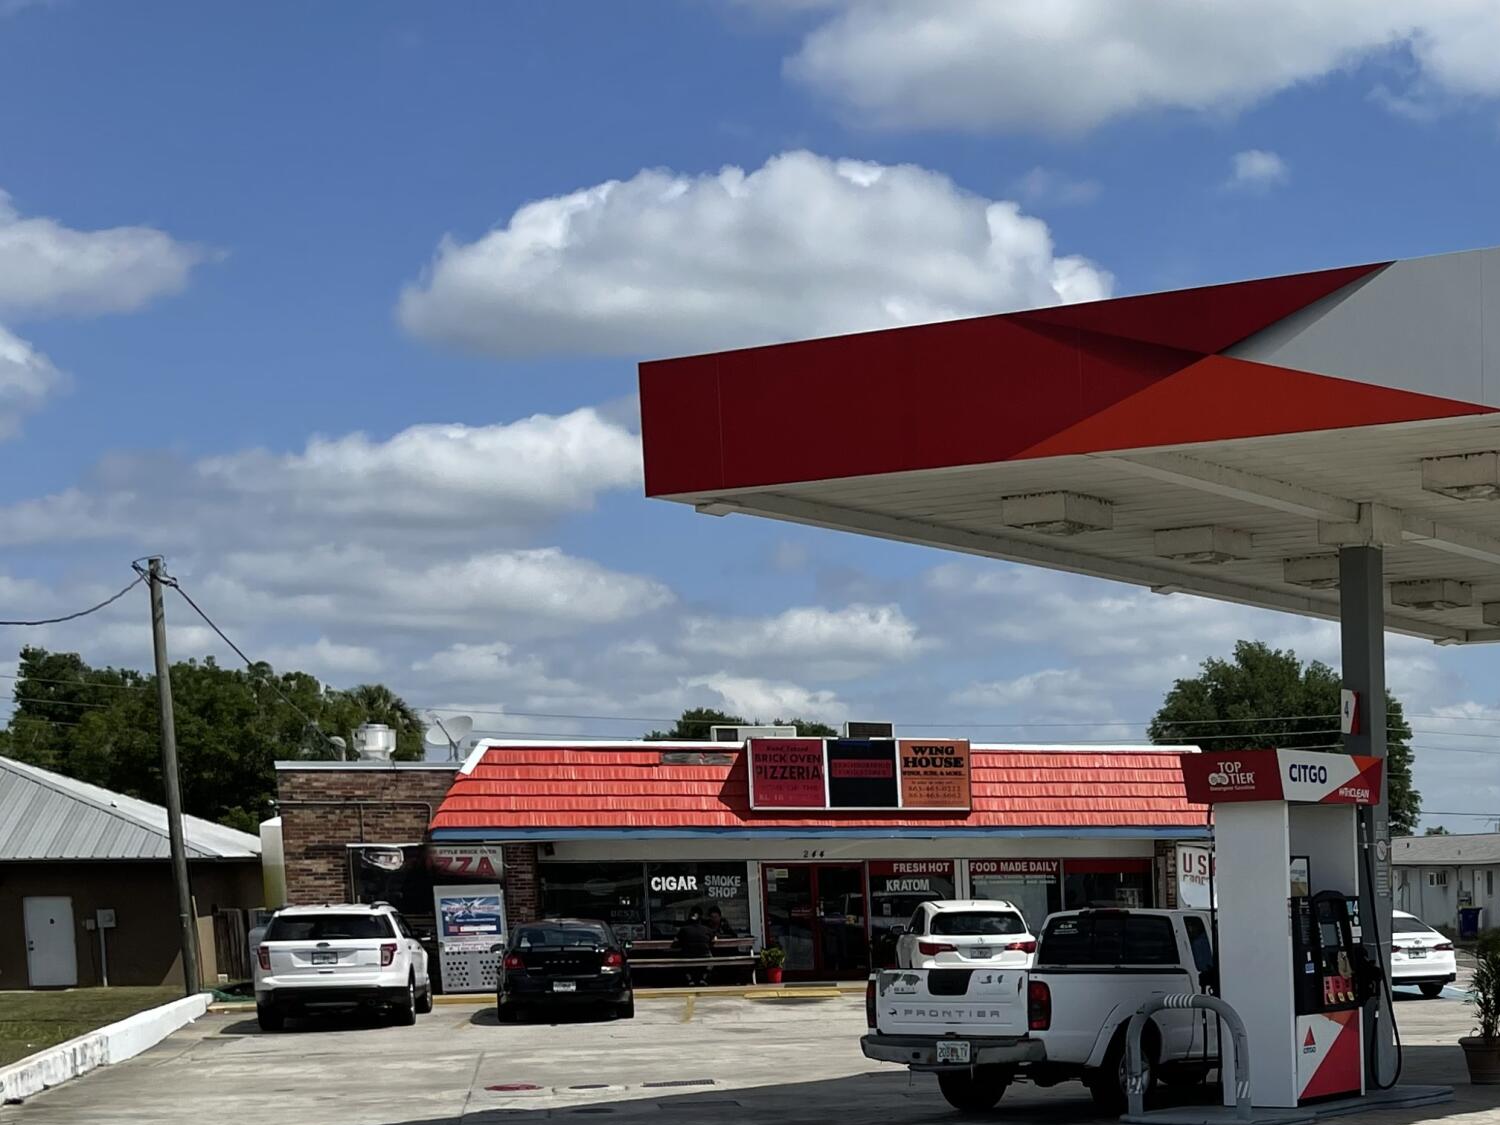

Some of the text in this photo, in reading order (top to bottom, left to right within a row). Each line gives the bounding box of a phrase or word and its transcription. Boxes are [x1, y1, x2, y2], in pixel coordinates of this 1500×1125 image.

[1344, 700, 1349, 718] 4
[911, 746, 955, 756] WING
[755, 753, 821, 763] BRICK OVEN
[902, 757, 965, 768] HOUSE
[754, 765, 821, 780] PIZZERIA
[1217, 761, 1242, 774] TOP
[1289, 764, 1327, 784] CITGO
[893, 861, 1058, 873] FRESH HOT FOOD MADE DAILY
[650, 875, 741, 892] CIGAR SMOKE
[886, 879, 930, 892] KRATOM
[708, 886, 738, 898] SHOP
[1353, 900, 1358, 915] 4
[904, 1009, 1000, 1018] FRONTIER
